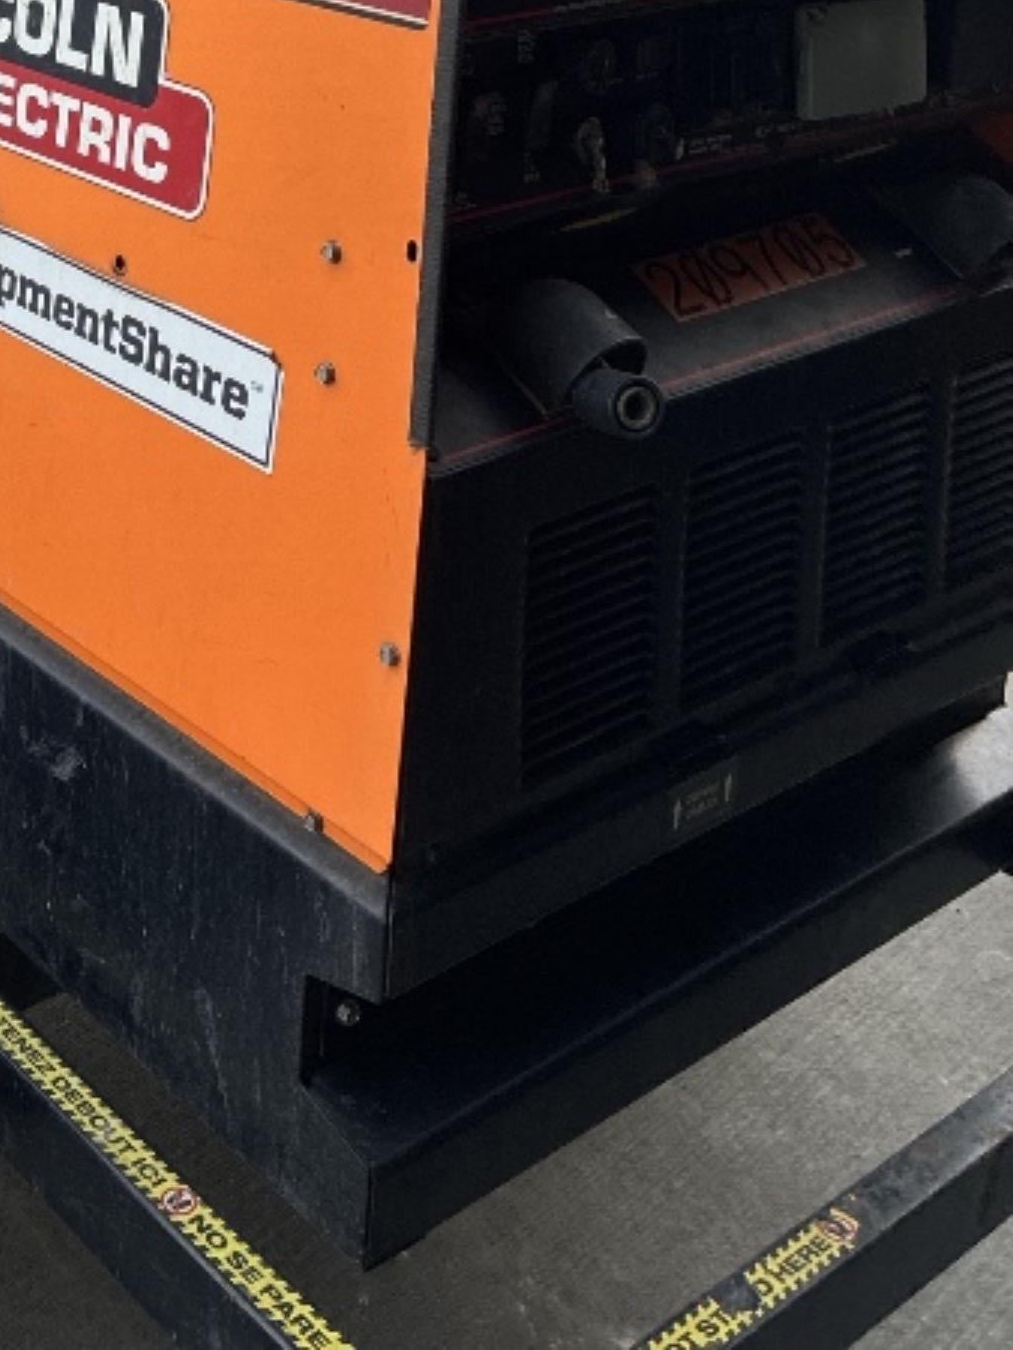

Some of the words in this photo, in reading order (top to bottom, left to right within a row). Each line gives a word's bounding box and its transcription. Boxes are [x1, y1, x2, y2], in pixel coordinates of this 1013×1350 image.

[645, 213, 856, 316] 209705
[51, 1076, 138, 1155] DEBOUT
[132, 1155, 168, 1188] ICI
[189, 1215, 228, 1250] NO
[225, 1250, 264, 1285] SE
[258, 1284, 332, 1350] PARE
[771, 1237, 831, 1279] HERE
